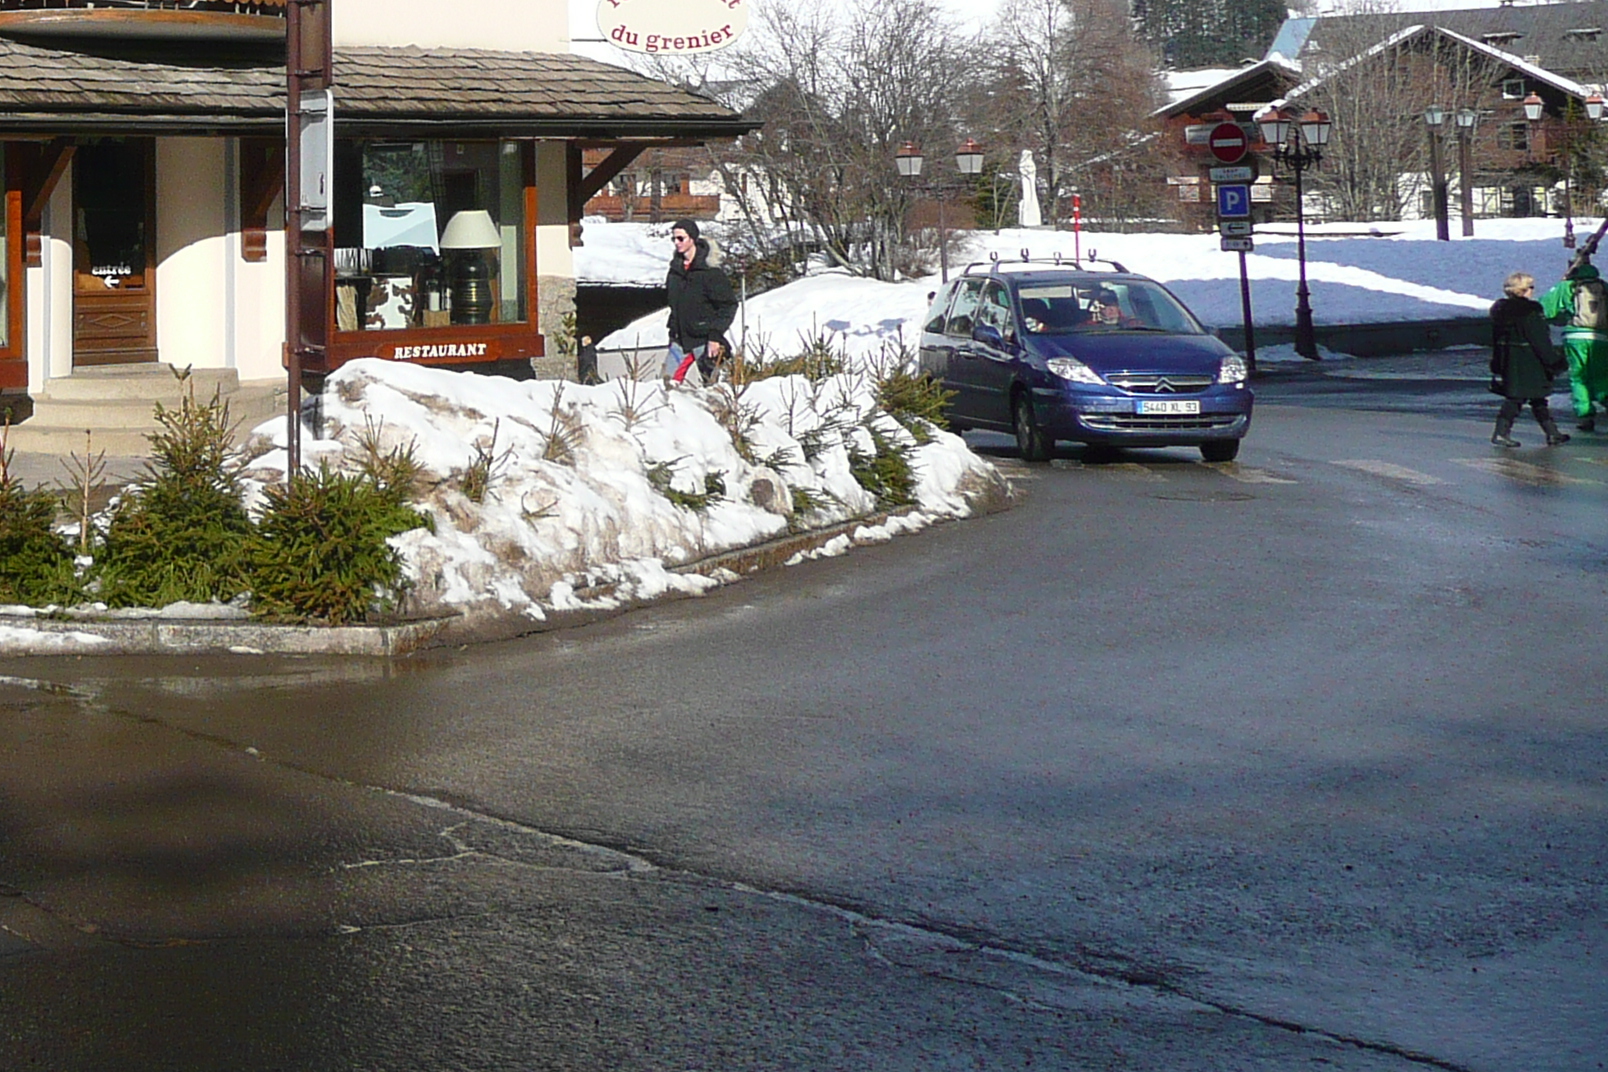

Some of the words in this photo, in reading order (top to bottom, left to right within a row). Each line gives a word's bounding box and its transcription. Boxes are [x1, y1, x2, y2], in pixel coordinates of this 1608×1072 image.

[610, 24, 640, 47] du
[645, 22, 734, 53] grenier
[92, 261, 131, 275] entrée
[394, 343, 487, 359] RESTAURANT
